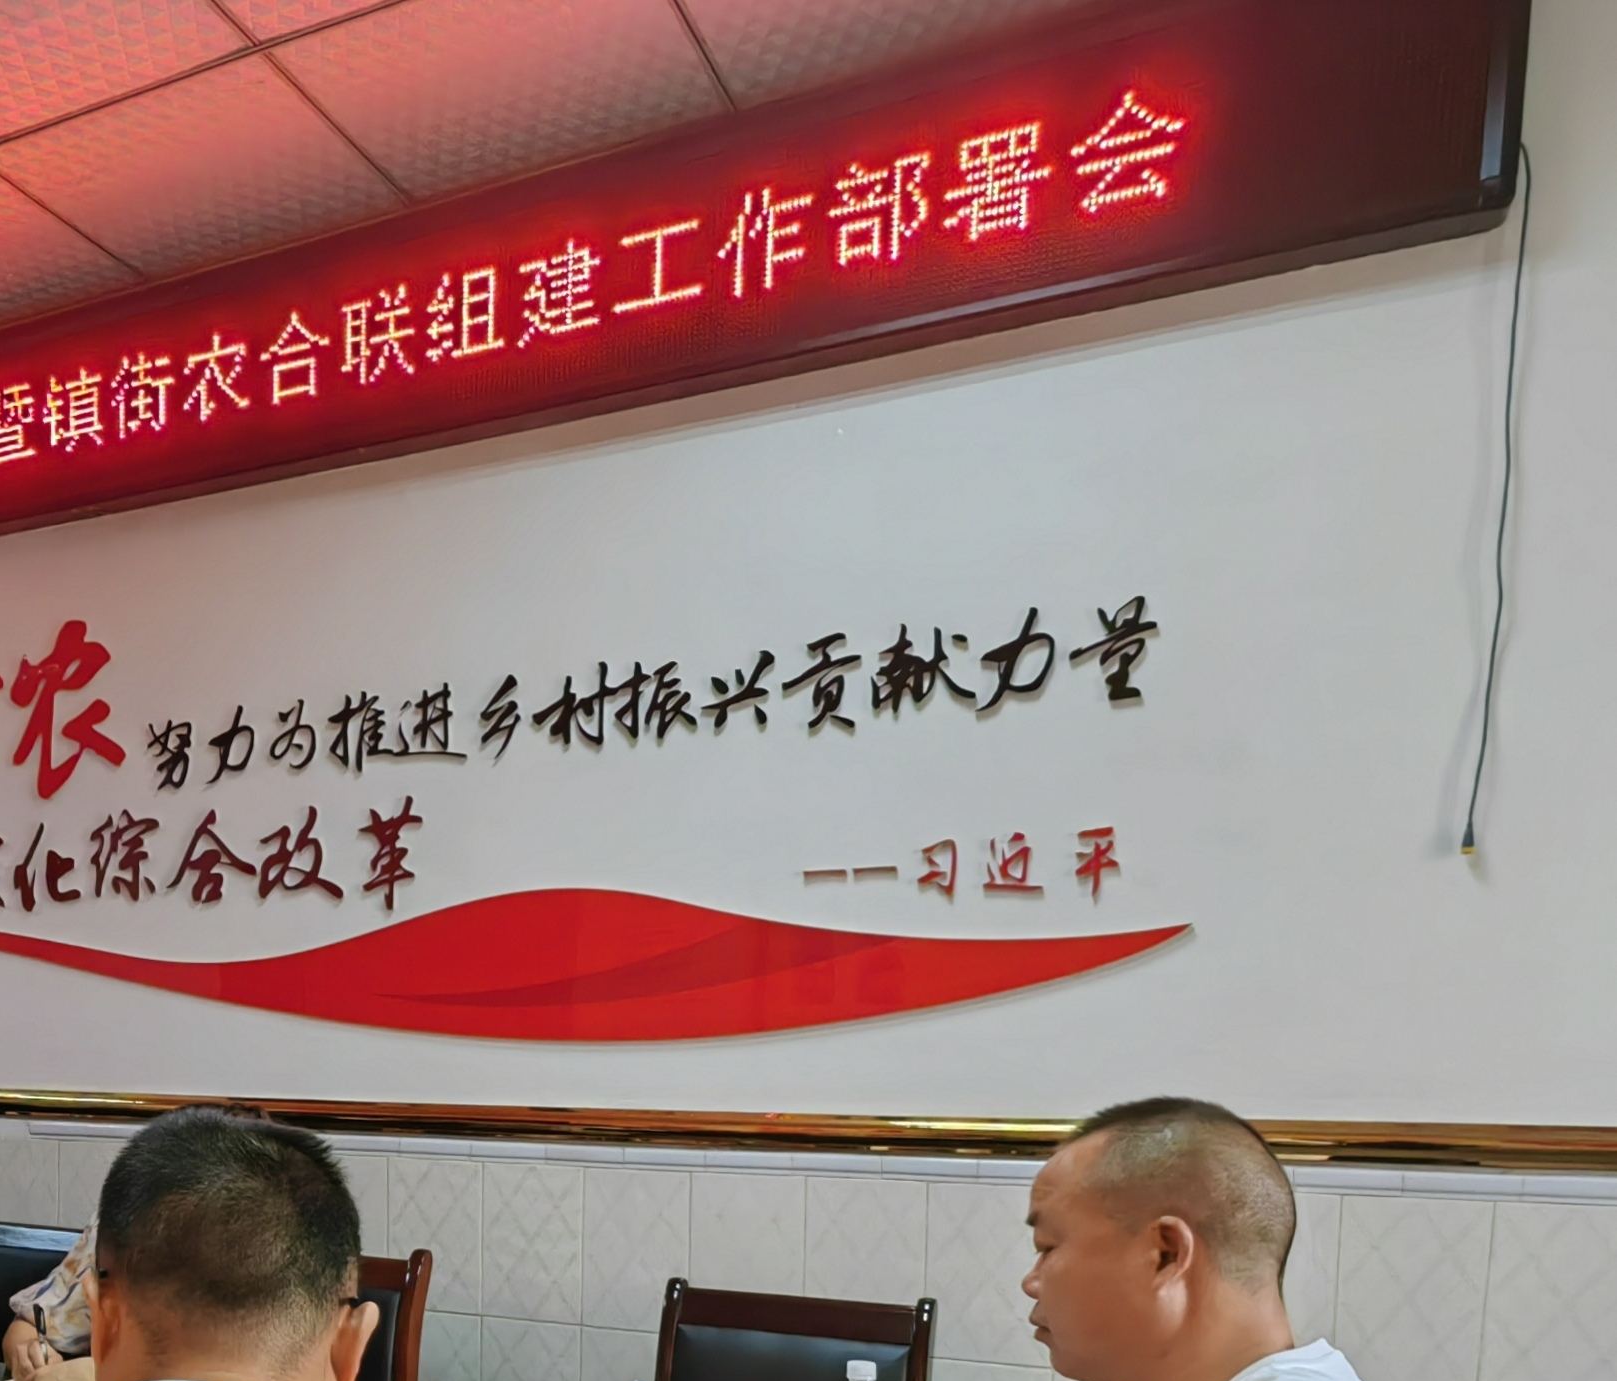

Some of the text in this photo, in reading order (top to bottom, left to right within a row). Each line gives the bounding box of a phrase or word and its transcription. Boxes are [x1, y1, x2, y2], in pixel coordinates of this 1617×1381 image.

[147, 595, 1159, 792] 努力为推进乡村振兴贡献力量
